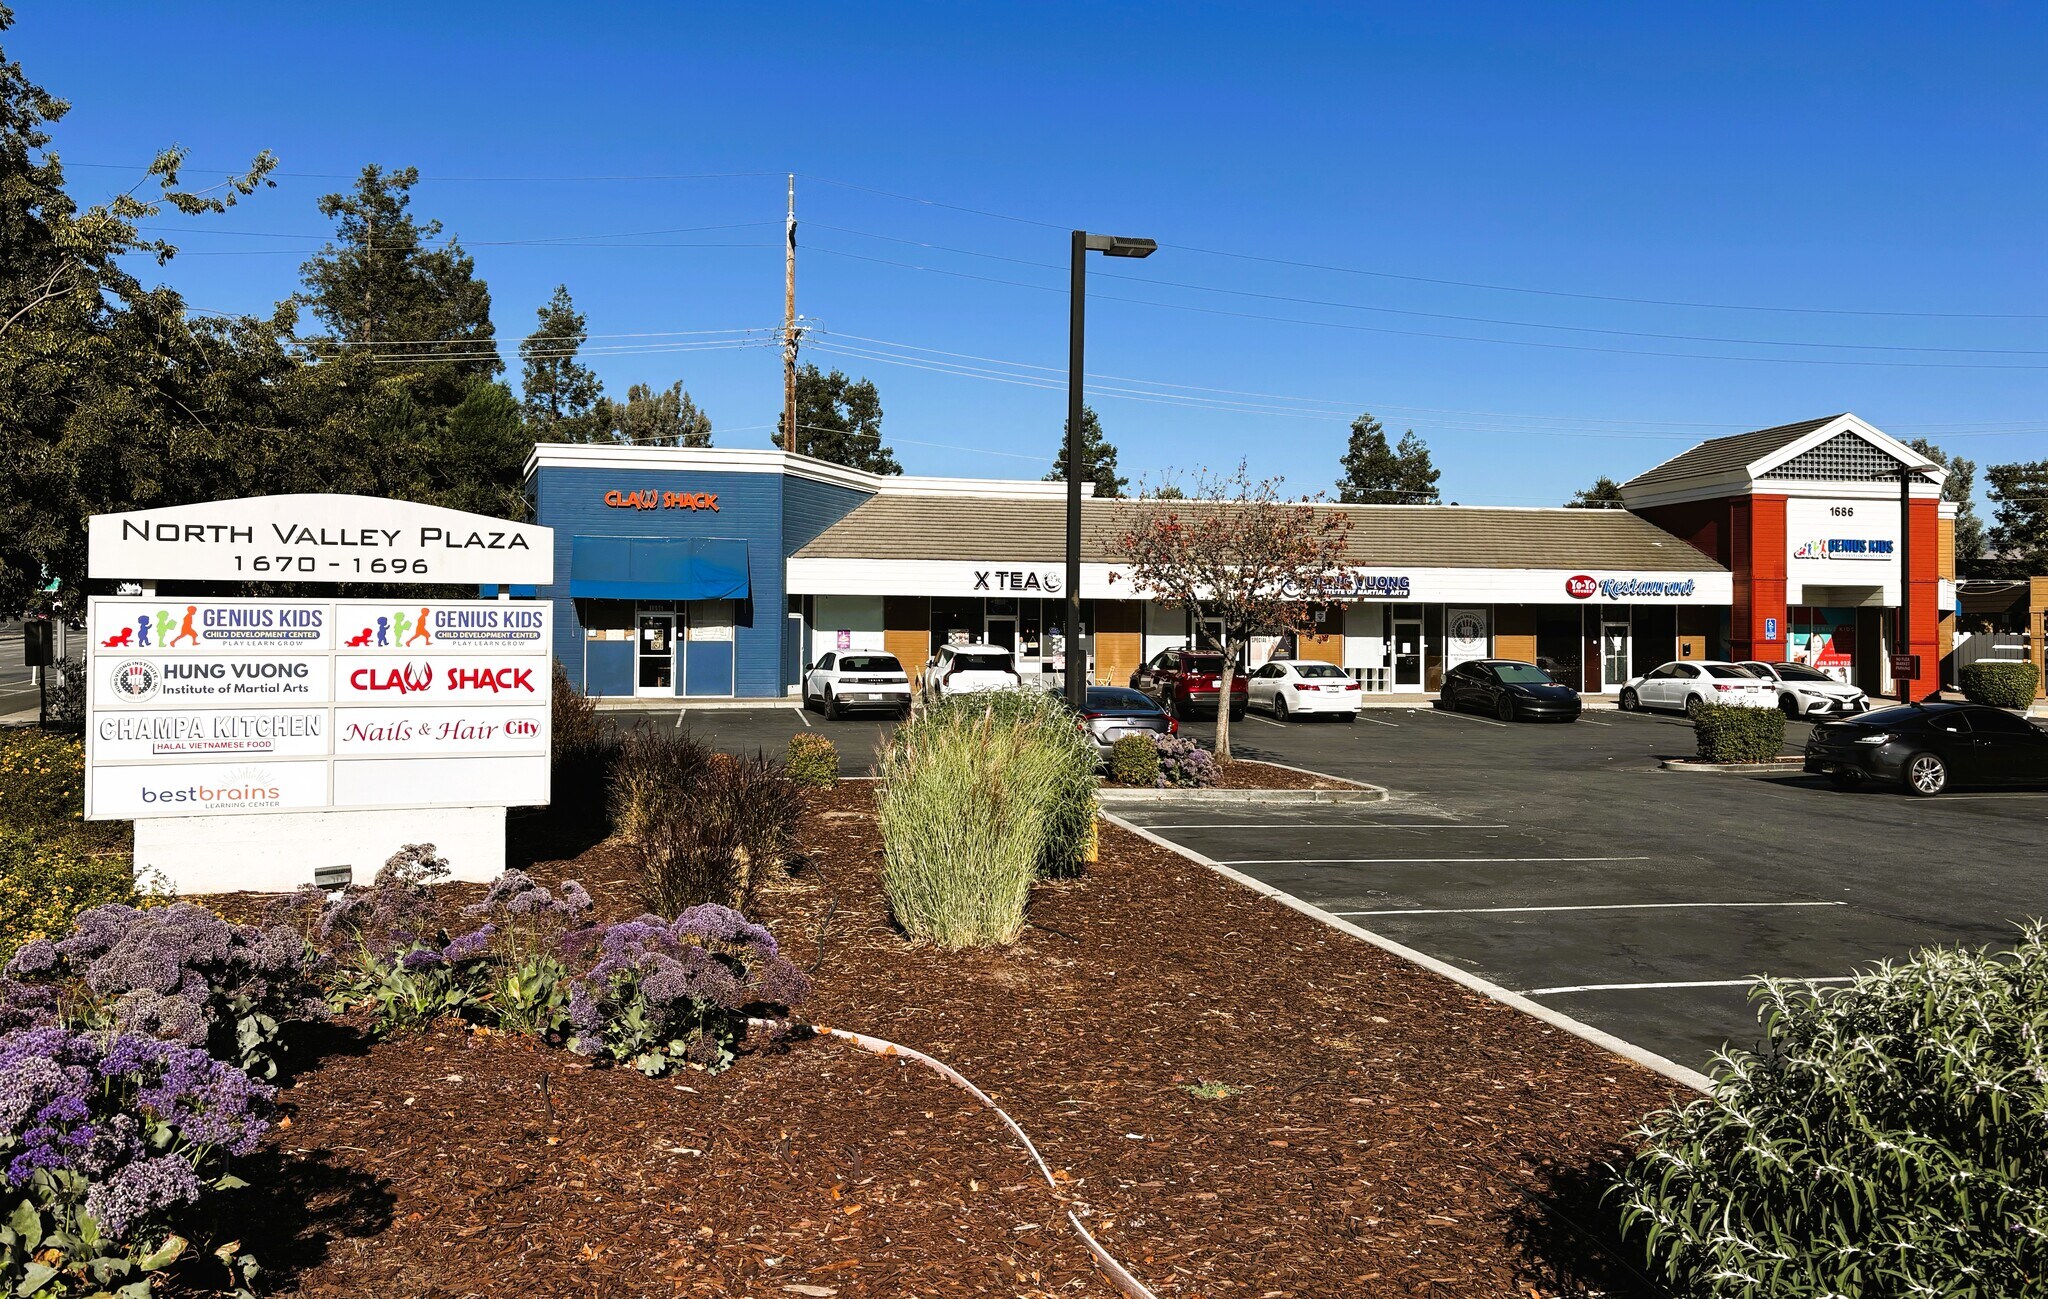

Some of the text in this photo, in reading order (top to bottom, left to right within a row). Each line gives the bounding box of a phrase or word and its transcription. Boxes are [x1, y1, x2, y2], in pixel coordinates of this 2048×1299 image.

[604, 489, 720, 513] CLAW SHACK
[1830, 506, 1854, 517] 1686
[122, 519, 530, 550] NORTH VALLEY PLAZA
[1828, 538, 1894, 554] GENIUS KIDS
[234, 556, 316, 572] 1670
[354, 558, 428, 574] 1696
[974, 571, 1041, 591] X TEA
[1599, 578, 1695, 600] Restaurant
[203, 608, 322, 628] GENIUS KIDS
[435, 610, 543, 628] GENIUS KIDS
[289, 631, 318, 639] CENTER
[437, 631, 458, 639] CHILD
[459, 631, 511, 639] DEVELOPMENT
[164, 663, 309, 680] HUNG VUONG
[350, 662, 535, 695] CLAW SHACK
[163, 682, 309, 694] Institute of Martial Arts
[100, 714, 321, 740] CHAMPA KITCHEN
[342, 719, 539, 742] Nails & Hair City
